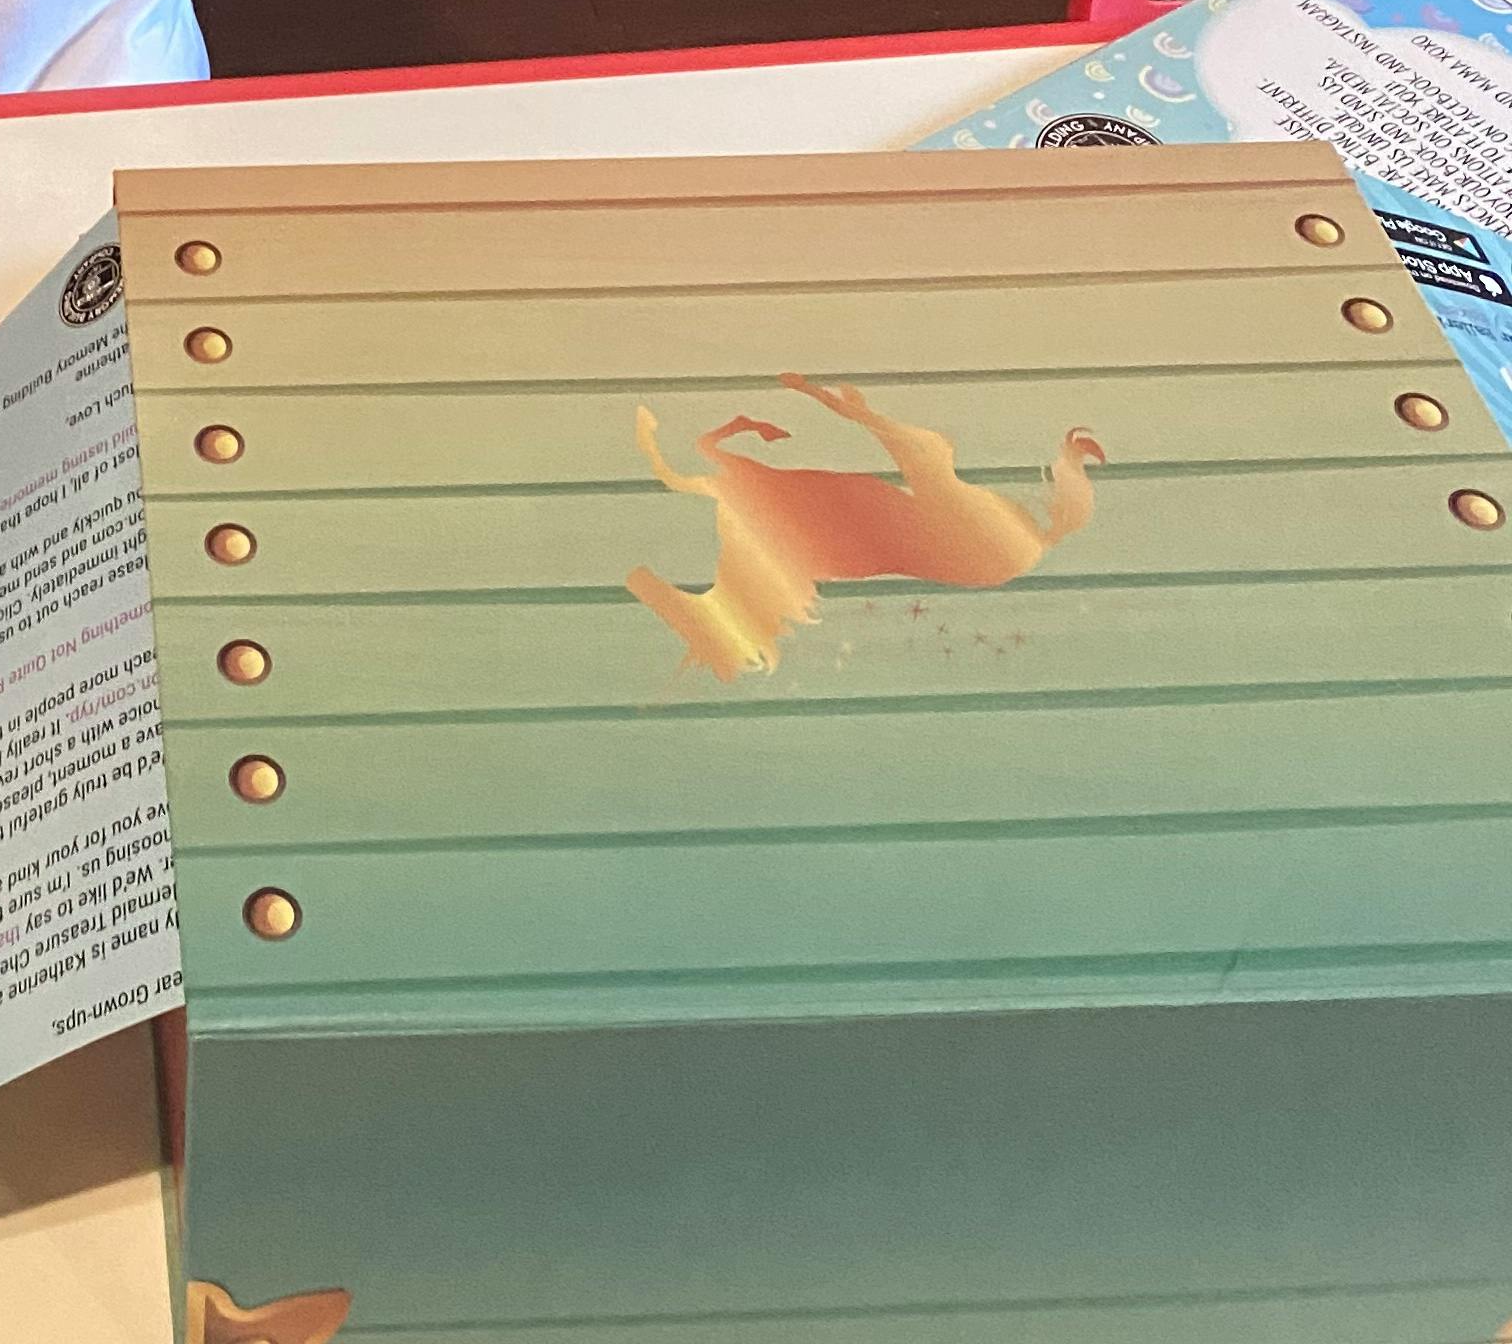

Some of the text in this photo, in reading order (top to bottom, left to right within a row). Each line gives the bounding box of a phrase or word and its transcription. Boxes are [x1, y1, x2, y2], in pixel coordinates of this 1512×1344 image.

[1375, 52, 1411, 74] AND
[1449, 59, 1497, 92] MAMA
[1317, 75, 1344, 95] US
[1404, 67, 1485, 128] FACEBOOK
[1339, 93, 1384, 122] SEND
[1372, 92, 1430, 133] SOCIAL
[1380, 122, 1416, 144] AND
[1419, 105, 1485, 149] FEATURE
[1423, 130, 1452, 148] ON
[1479, 124, 1508, 142] ON
[1387, 148, 1414, 168] US
[1412, 141, 1459, 177] BOOK
[1479, 147, 1505, 166] TO
[1409, 166, 1456, 196] MAKE
[55, 333, 108, 374] Memory
[2, 368, 52, 410] Building
[50, 637, 77, 663] Not
[8, 653, 46, 684] Quite
[111, 806, 142, 836] you
[44, 834, 79, 869] your
[83, 826, 106, 849] for
[7, 858, 40, 892] kind
[46, 870, 71, 894] I'm
[111, 863, 153, 897] We'd
[8, 885, 41, 914] sure
[56, 897, 73, 917] to
[77, 882, 107, 907] like
[111, 882, 177, 926] ermaid
[24, 908, 52, 934] say
[34, 911, 106, 956] Treasure
[110, 918, 159, 950] name
[90, 940, 106, 960] is
[7, 948, 86, 999] Katherine
